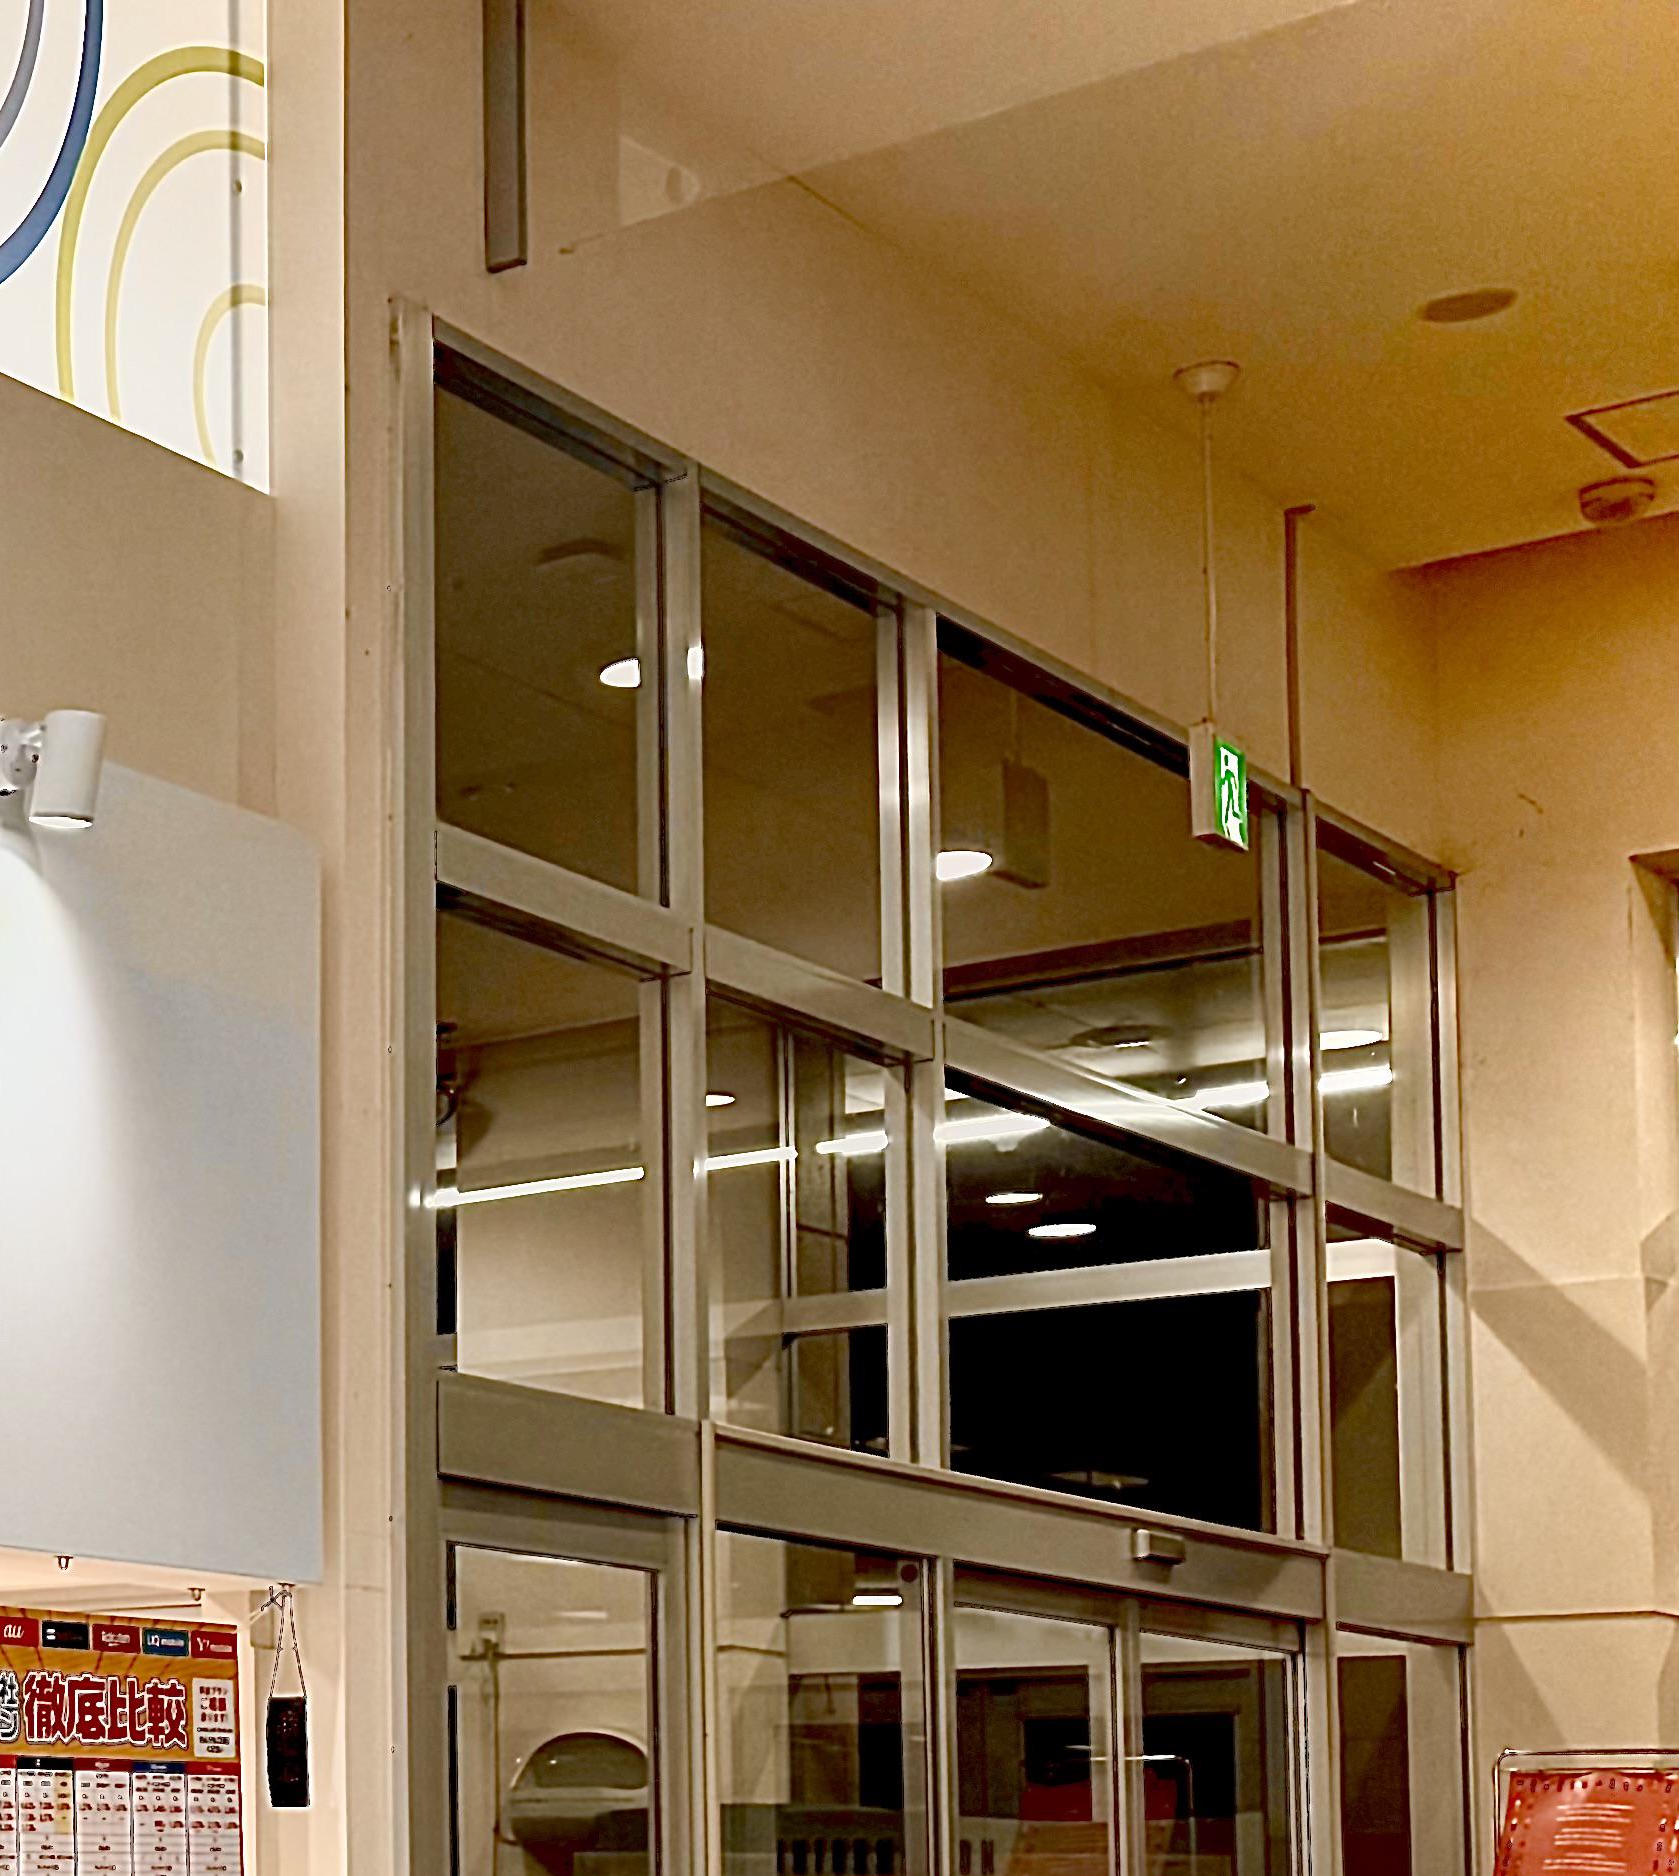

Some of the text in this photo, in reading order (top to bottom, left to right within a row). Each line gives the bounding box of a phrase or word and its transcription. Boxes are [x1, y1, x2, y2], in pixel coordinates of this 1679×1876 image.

[3, 1624, 25, 1639] au
[23, 1672, 187, 1749] 徹底比較
